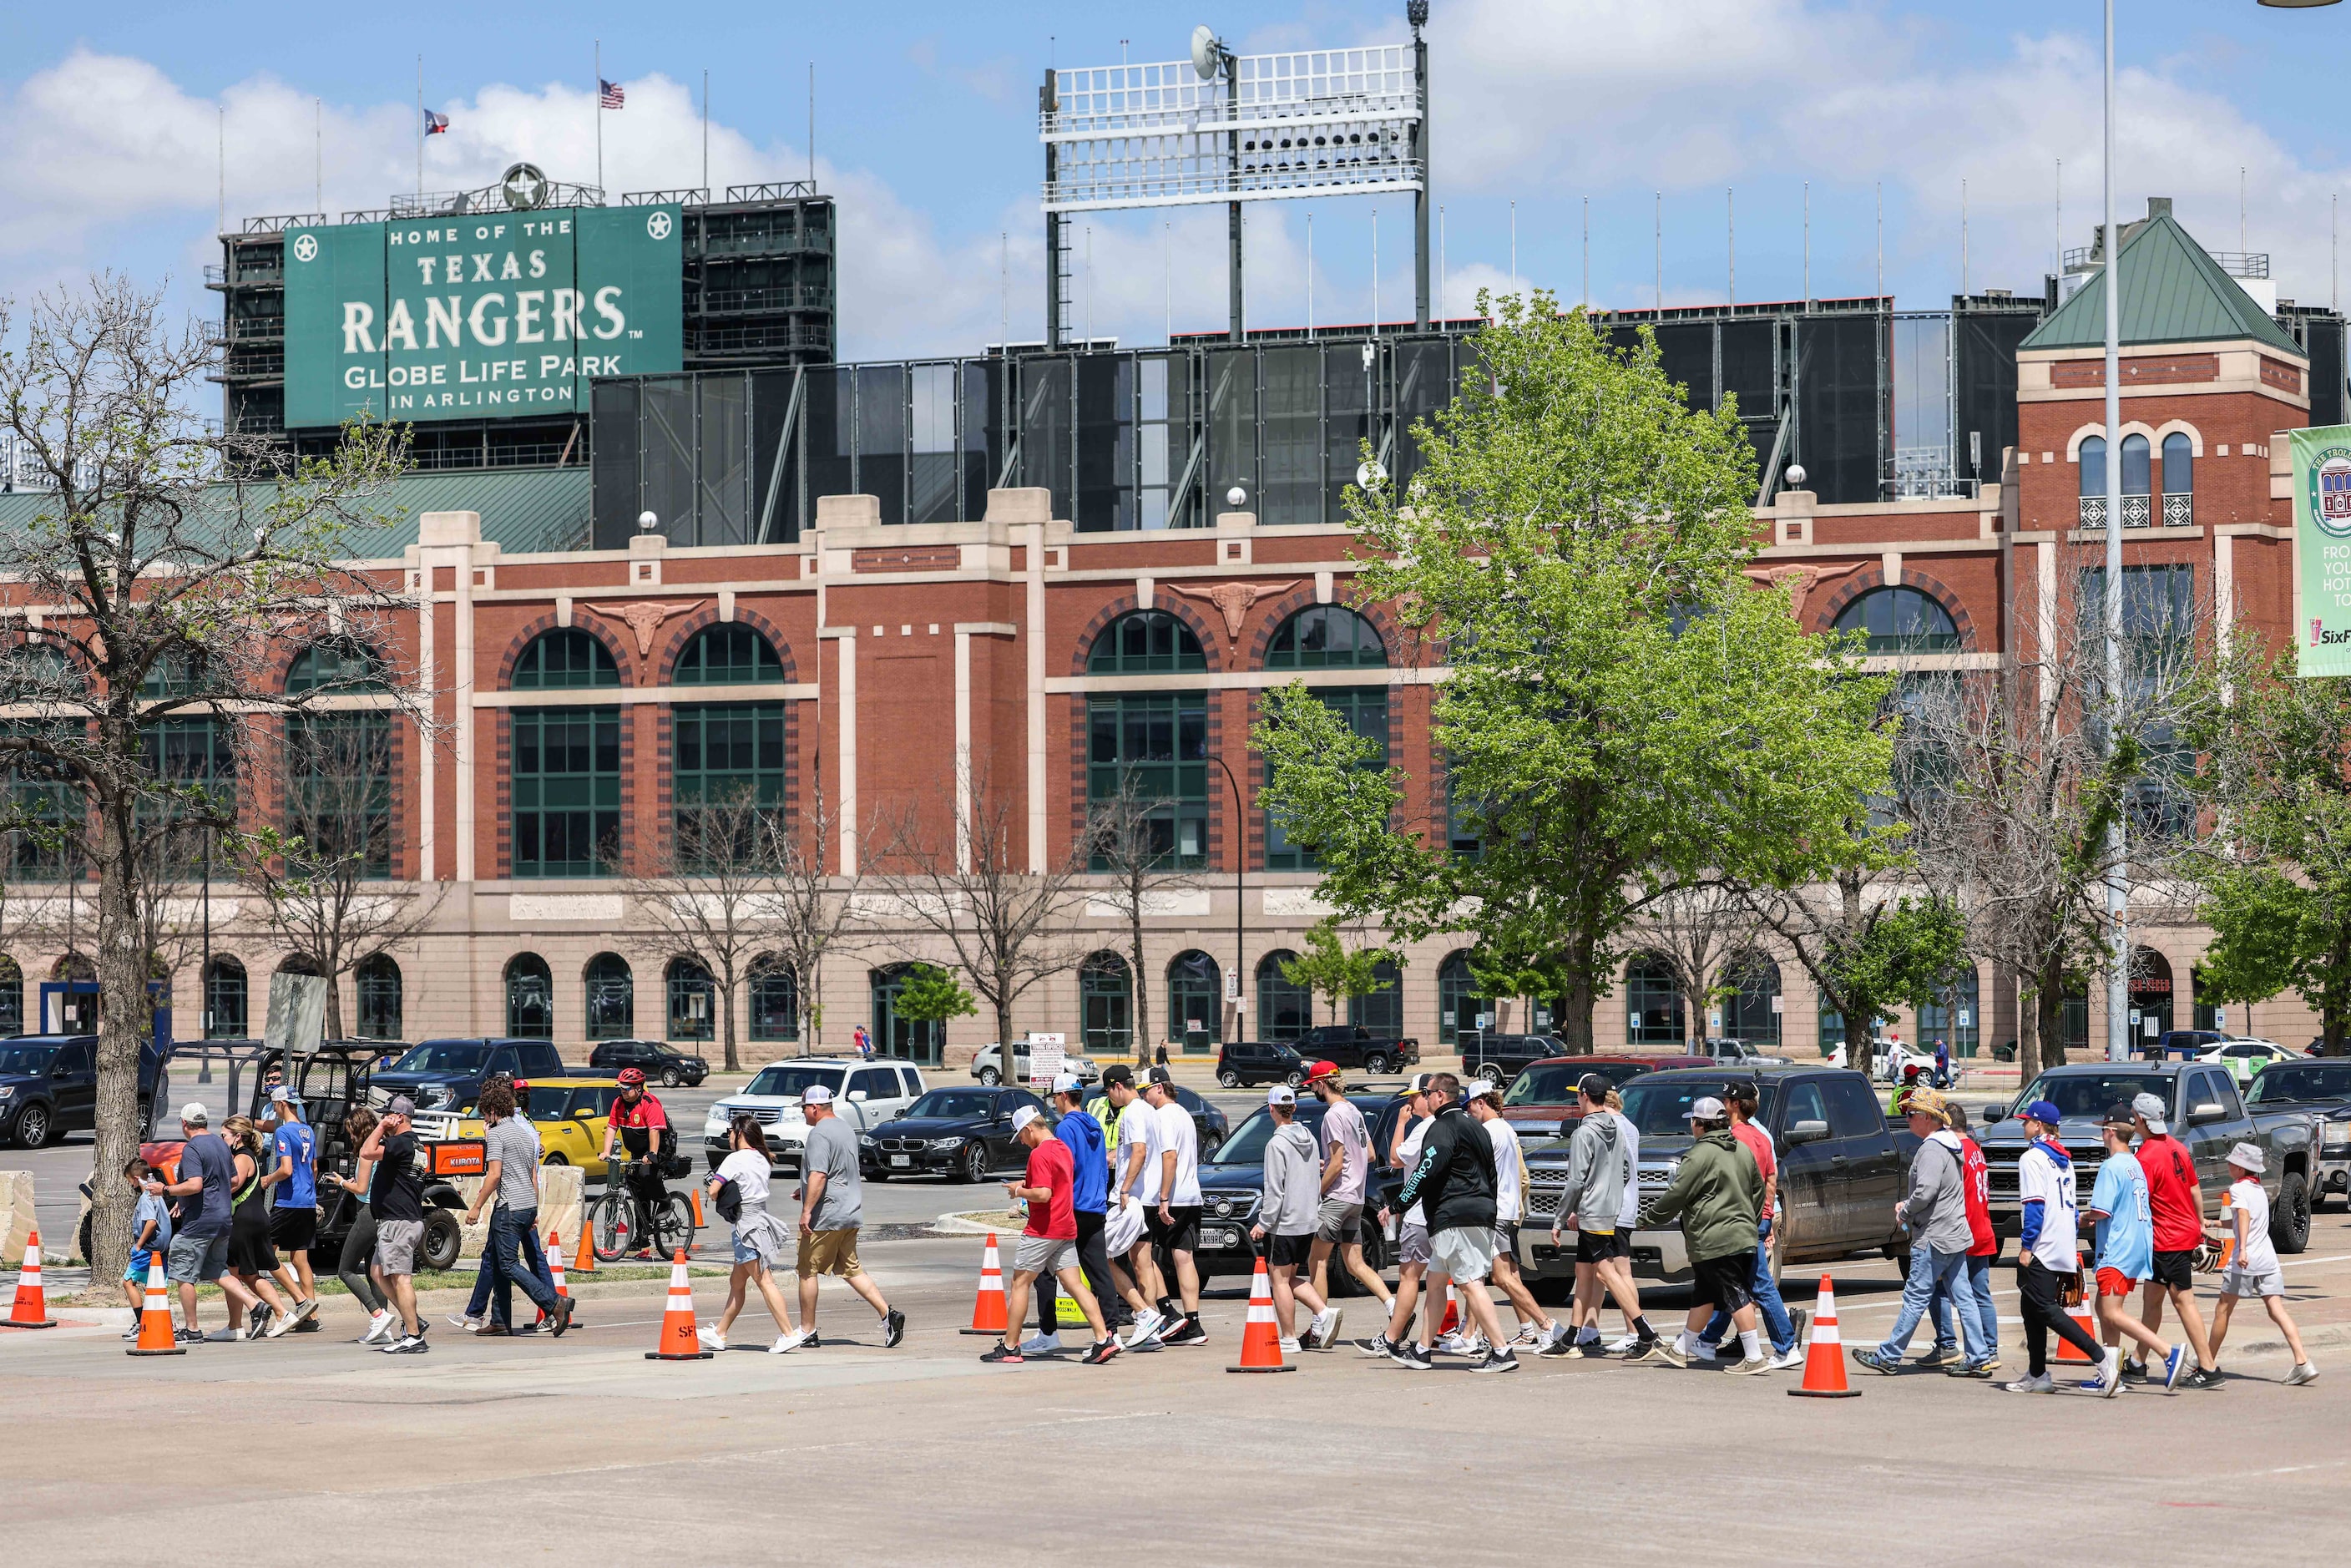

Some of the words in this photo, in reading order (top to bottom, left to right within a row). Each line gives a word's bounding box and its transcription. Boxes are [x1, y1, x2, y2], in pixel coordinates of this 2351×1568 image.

[390, 228, 458, 246] HOME
[476, 225, 506, 240] OF
[523, 220, 571, 235] THE
[417, 249, 547, 286] TEXAS
[341, 286, 626, 355] RANGERS
[628, 330, 644, 340] TM
[344, 364, 447, 390] GLOBE
[459, 355, 527, 383] LIFE
[540, 355, 622, 380] PARK
[391, 395, 414, 410] IN
[423, 386, 572, 407] ARLINGTON
[2312, 453, 2327, 470] THE
[2323, 545, 2350, 559] FRO
[2323, 577, 2351, 592] HOT
[451, 1157, 481, 1166] KUBOTA
[2172, 1149, 2187, 1184] 4
[1400, 1158, 1433, 1203] Columbia
[2056, 1176, 2075, 1211] 13
[2195, 1374, 2207, 1383] N
